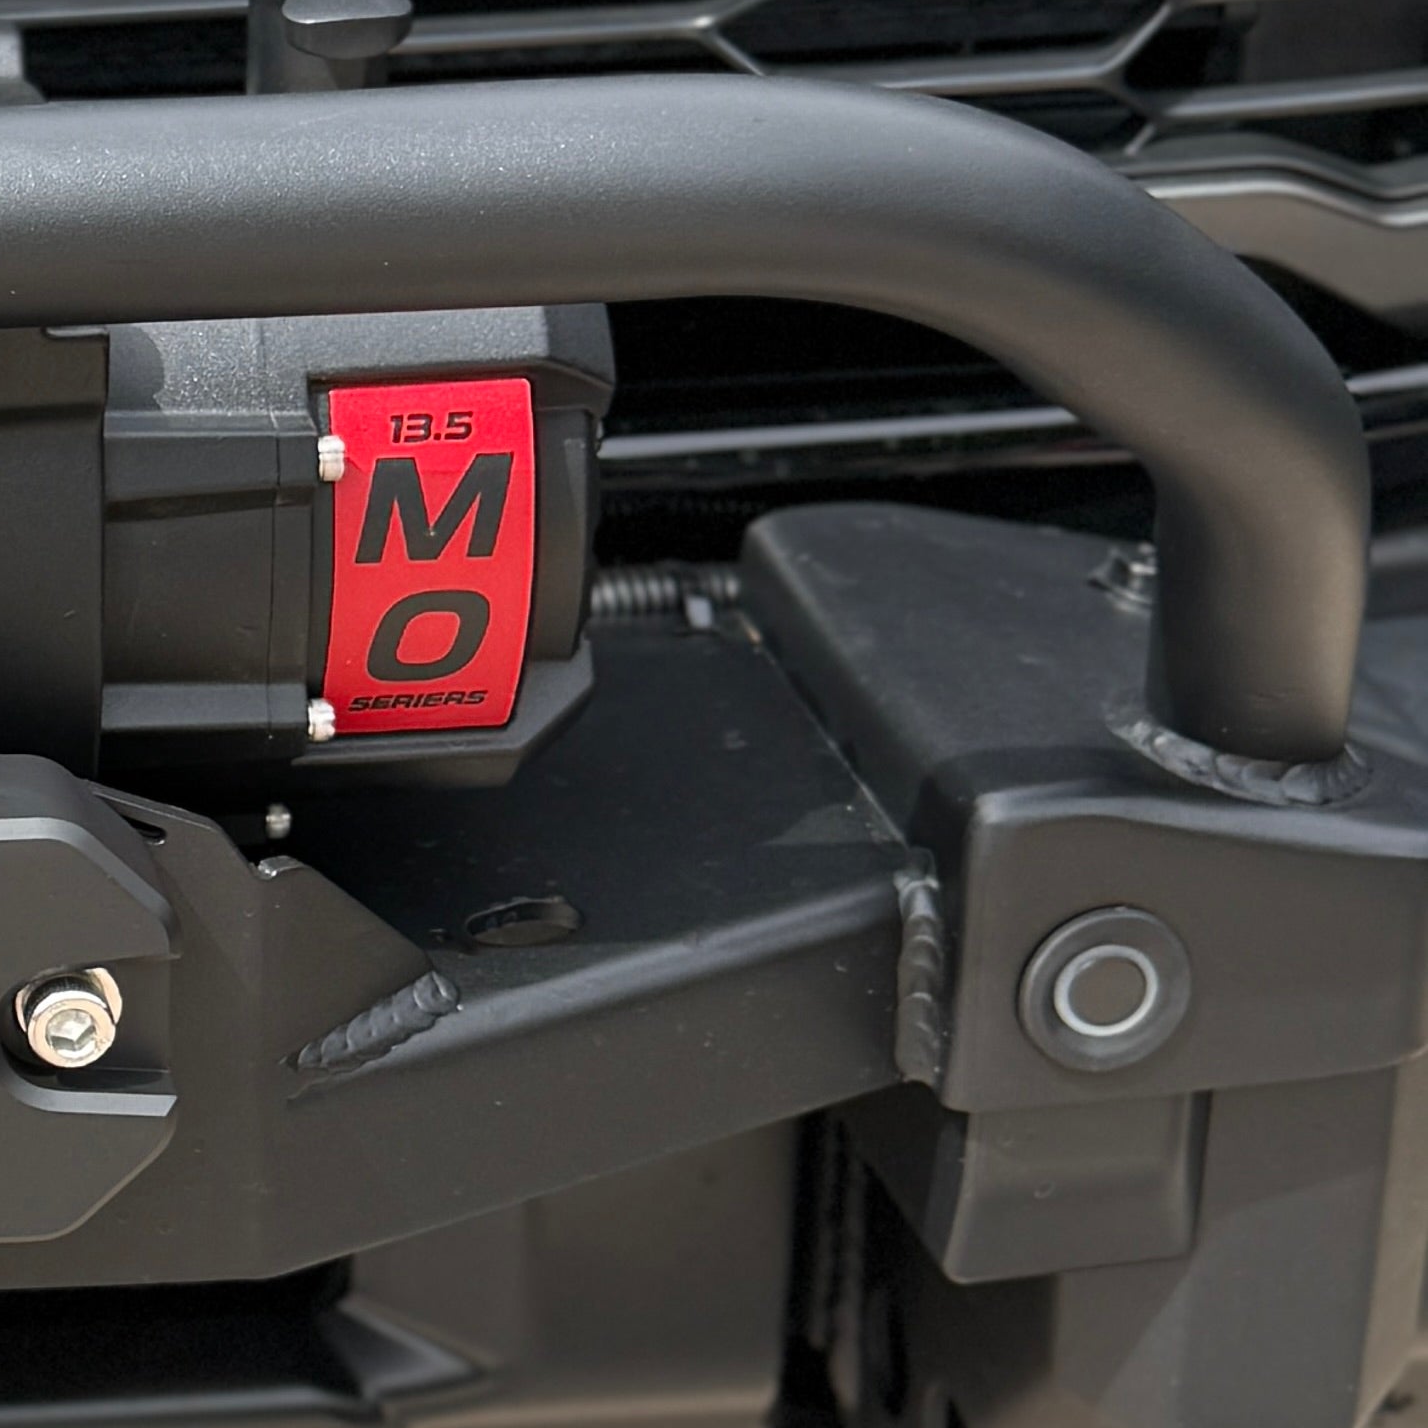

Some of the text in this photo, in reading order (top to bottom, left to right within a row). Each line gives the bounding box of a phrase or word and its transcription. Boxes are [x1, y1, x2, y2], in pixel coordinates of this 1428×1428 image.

[389, 410, 473, 443] 13.5
[353, 451, 515, 564] M
[366, 588, 491, 683] O
